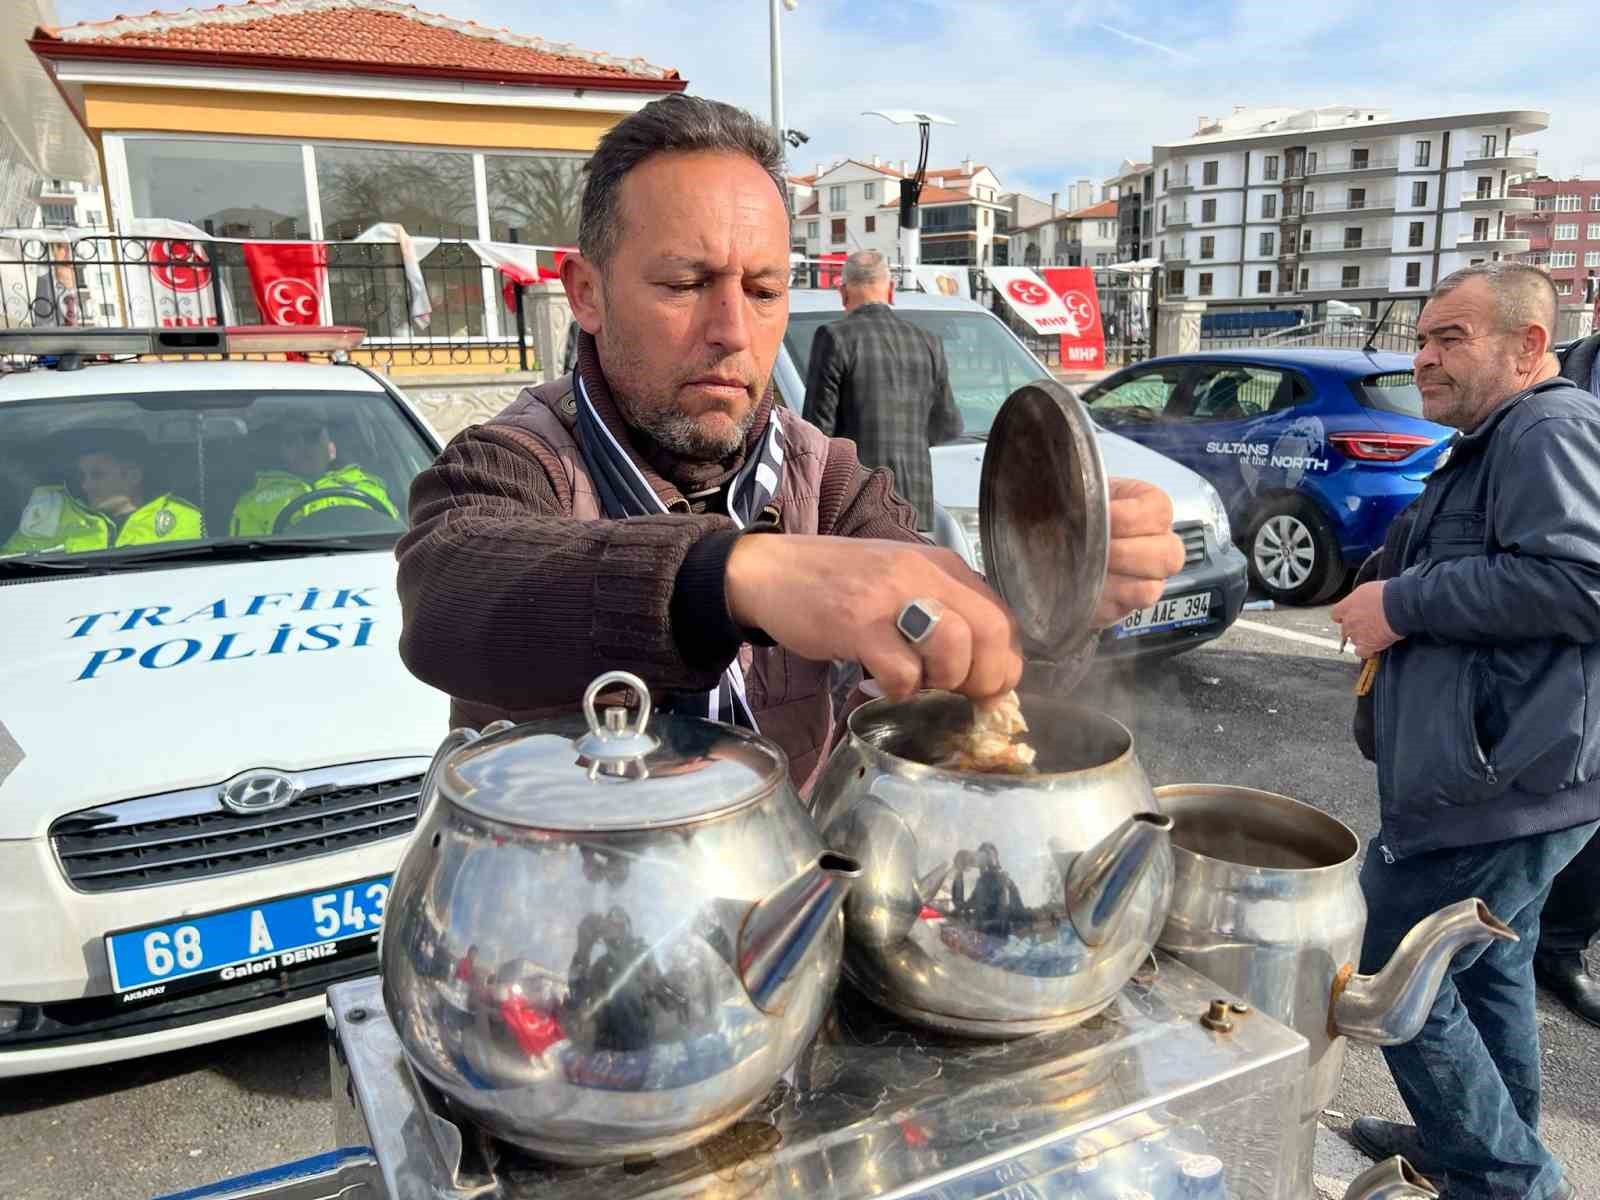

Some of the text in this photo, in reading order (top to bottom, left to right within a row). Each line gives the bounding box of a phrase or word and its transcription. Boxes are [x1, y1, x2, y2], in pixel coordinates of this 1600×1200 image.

[1035, 315, 1068, 328] MHP
[1068, 347, 1098, 361] MHP
[1206, 442, 1269, 456] SULTANS
[1240, 455, 1329, 471] of the NORTH
[64, 587, 378, 640] TRAFİK
[1151, 600, 1177, 624] AAE
[1184, 593, 1209, 618] 394
[72, 617, 381, 682] POLİSİ
[143, 883, 389, 976] 68 A 543
[220, 957, 277, 980] Galeri
[123, 985, 166, 1003] AKSARAY
